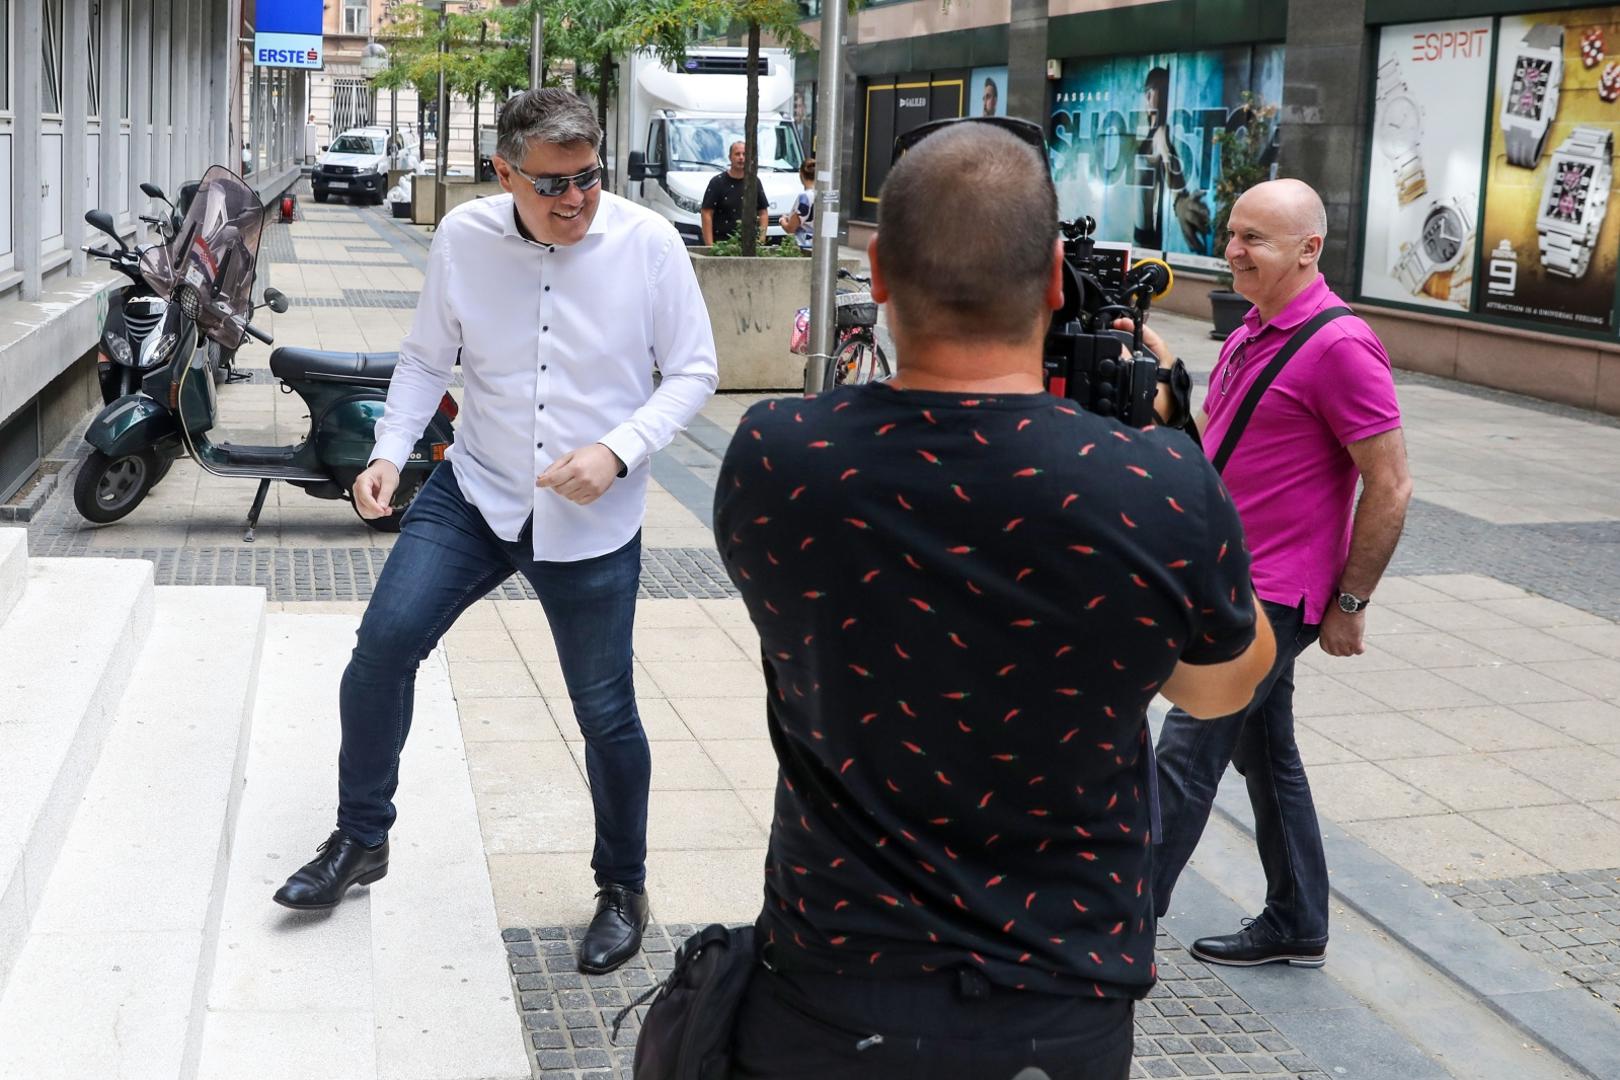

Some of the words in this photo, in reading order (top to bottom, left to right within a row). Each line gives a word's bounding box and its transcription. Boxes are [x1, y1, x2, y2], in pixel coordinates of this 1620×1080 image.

[258, 49, 305, 63] ERSTE
[1412, 28, 1488, 61] ESPRIT
[1056, 91, 1110, 102] PASSAGE
[1050, 109, 1158, 190] SHOE
